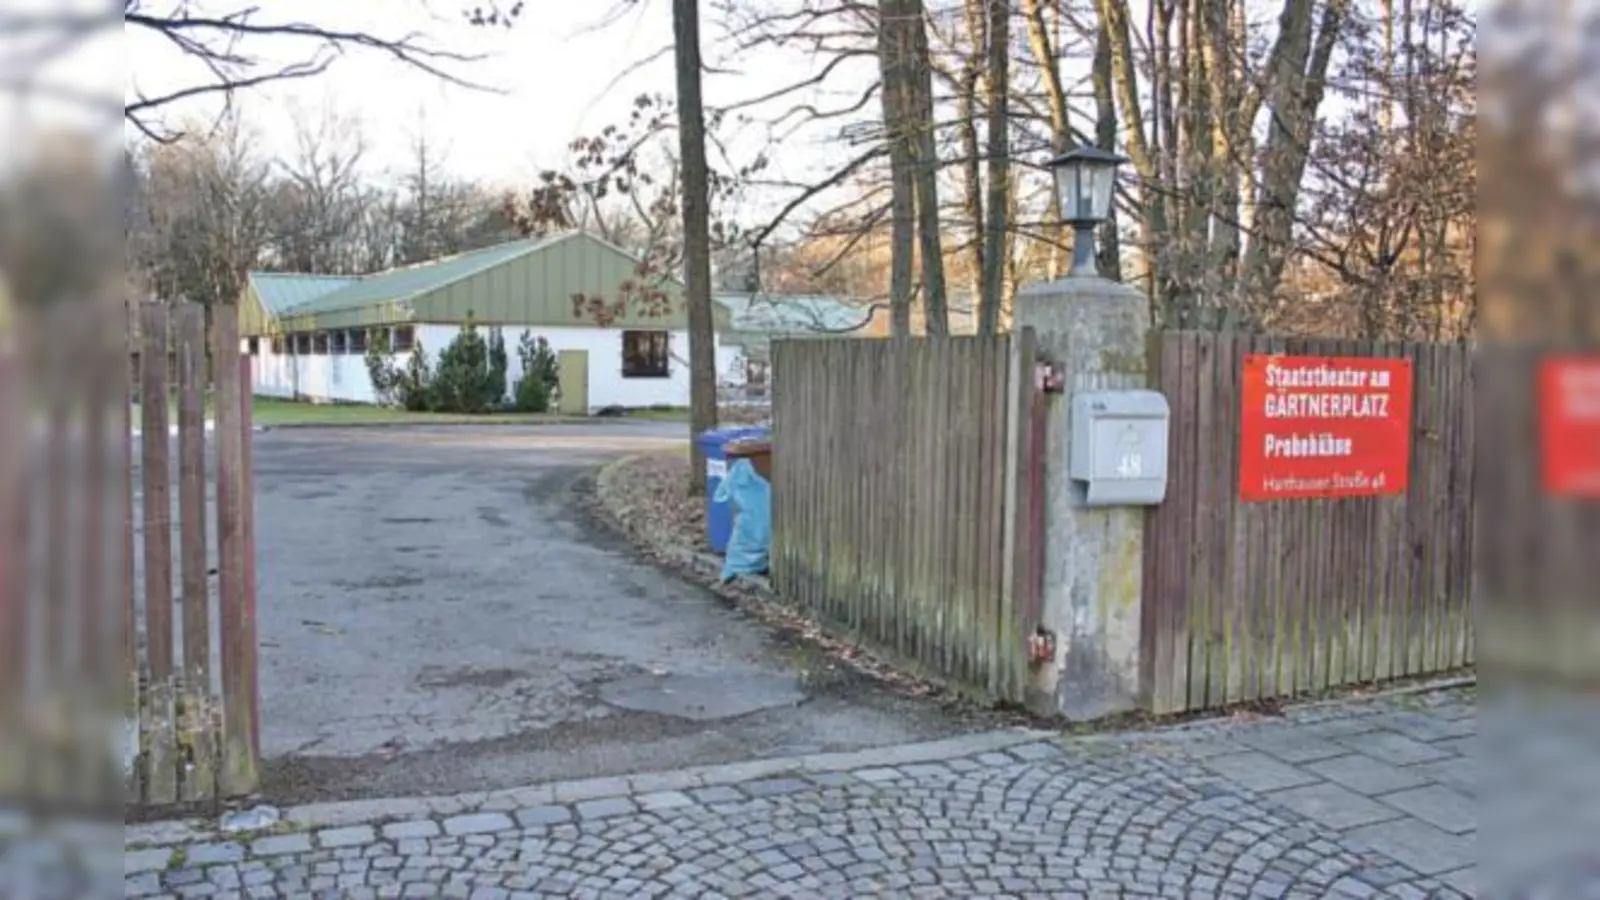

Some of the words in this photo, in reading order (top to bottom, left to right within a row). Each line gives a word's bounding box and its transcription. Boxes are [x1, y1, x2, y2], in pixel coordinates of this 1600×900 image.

[1369, 370, 1391, 388] am
[1264, 389, 1390, 418] GÄRTNERPLATZ
[1117, 453, 1142, 478] 48
